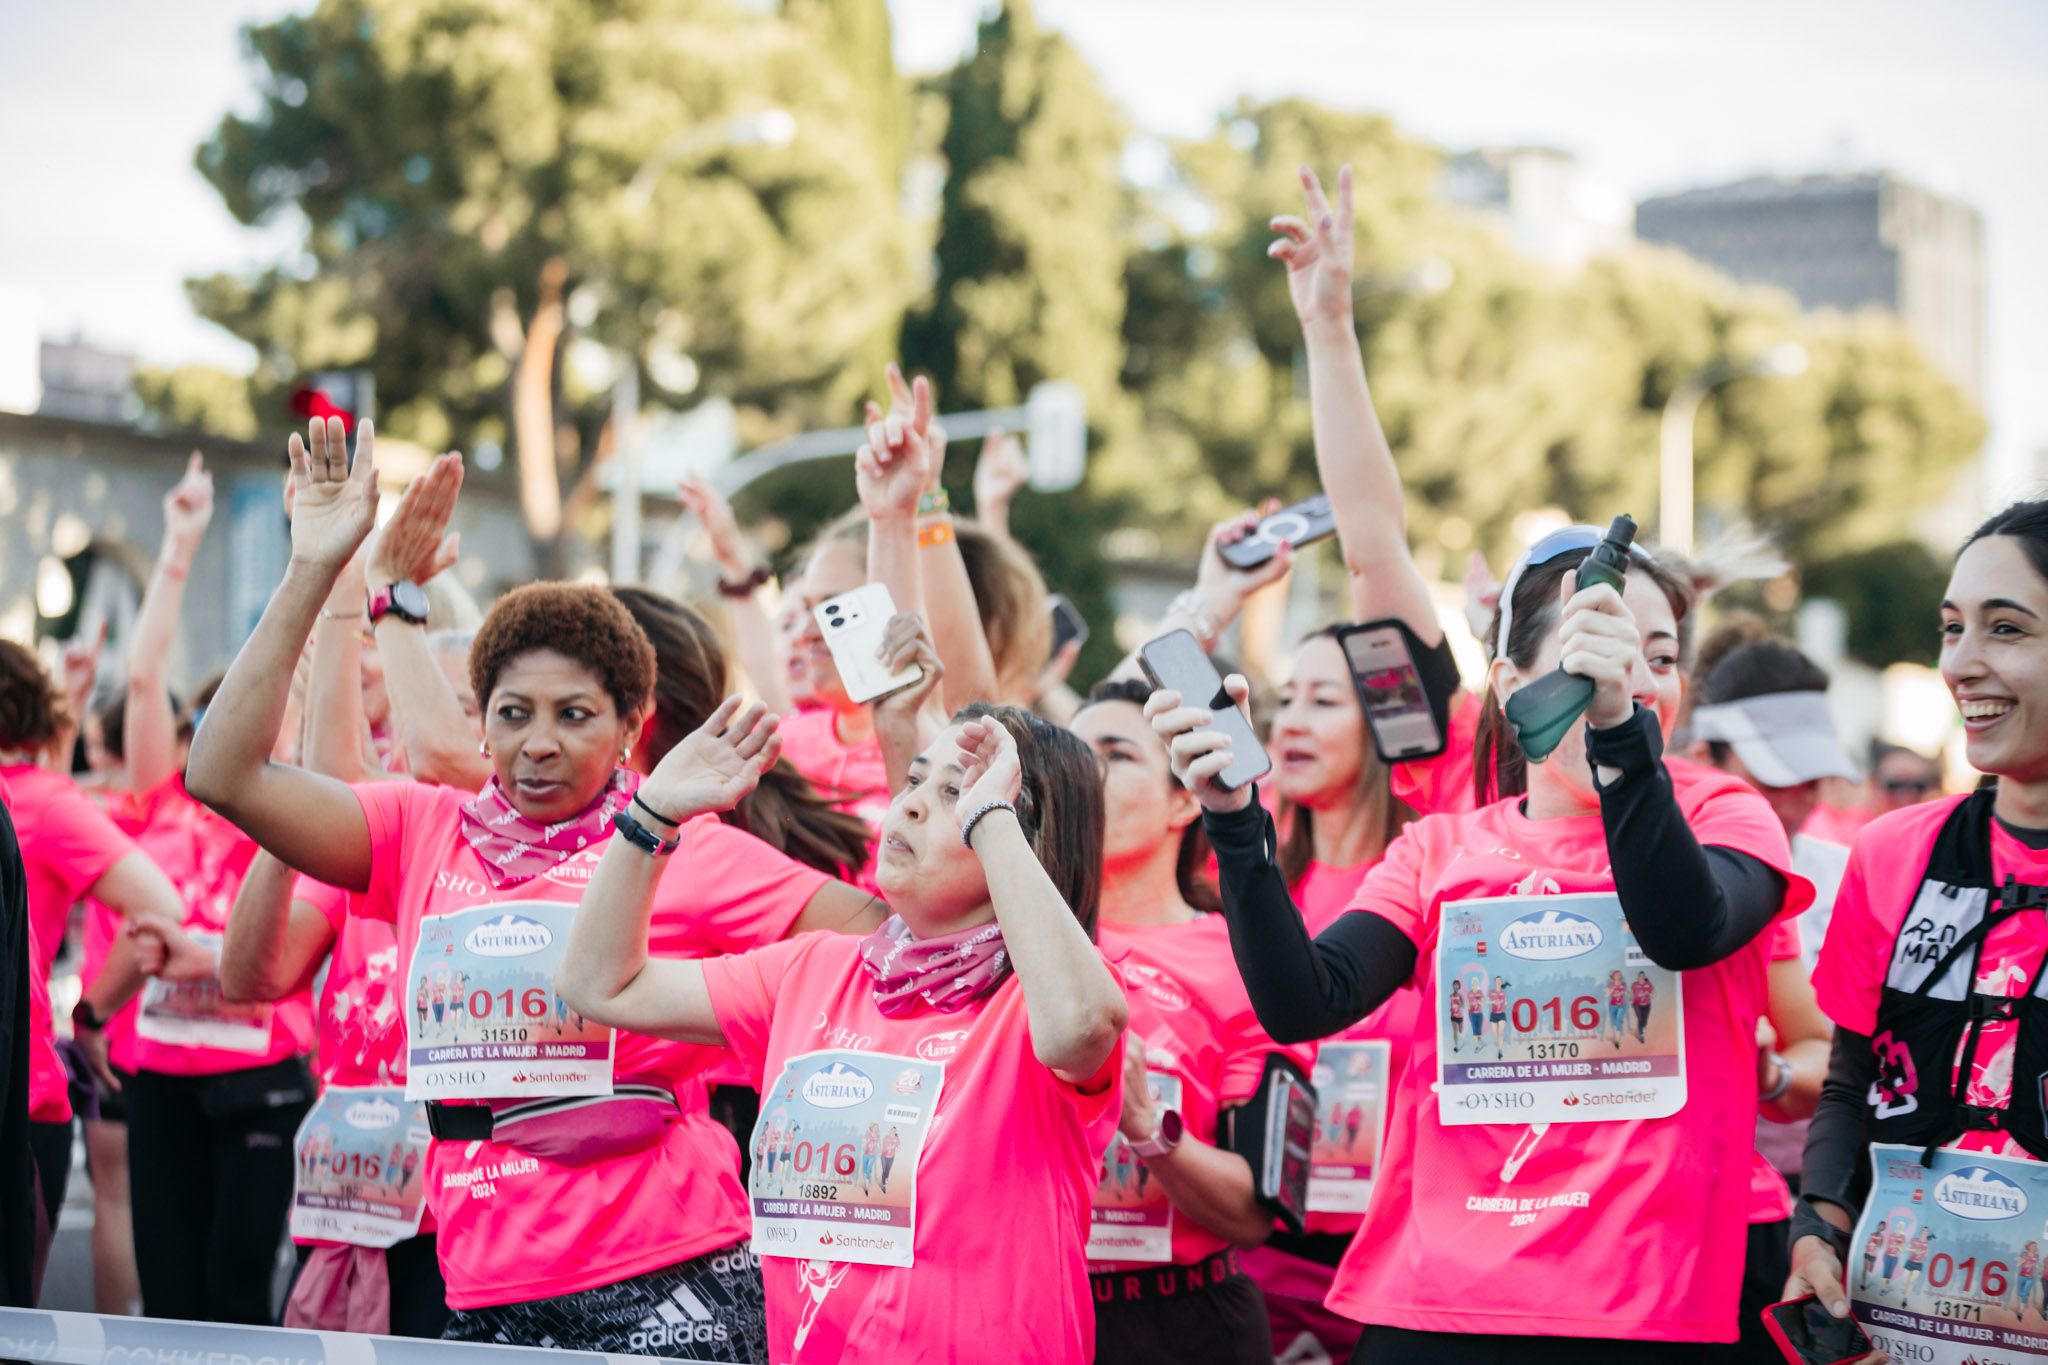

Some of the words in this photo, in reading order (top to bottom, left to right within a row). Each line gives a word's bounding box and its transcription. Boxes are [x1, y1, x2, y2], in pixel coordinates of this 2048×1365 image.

[470, 933, 547, 949] ASTURIANA
[1506, 930, 1596, 949] ASTURIANA
[1900, 942, 1952, 966] MA
[469, 988, 548, 1019] 016
[1512, 996, 1600, 1033] 016
[481, 1028, 528, 1042] 31510
[428, 1048, 469, 1062] CARRERA
[471, 1047, 485, 1058] DE
[487, 1046, 500, 1058] LA
[503, 1045, 537, 1057] MUJER
[545, 1044, 587, 1057] MADRID
[1528, 1043, 1579, 1059] 13170
[426, 1070, 486, 1087] OYSHO
[529, 1070, 588, 1083] Santander
[1467, 1066, 1514, 1080] CARRERA
[1517, 1065, 1532, 1078] DE
[1535, 1064, 1549, 1077] LA
[1551, 1063, 1592, 1076] MUJER
[1602, 1061, 1652, 1075] MADRID
[806, 1081, 867, 1099] ASTURIANA
[1583, 1090, 1657, 1106] Santander
[1466, 1092, 1535, 1110] OYSHO
[331, 1152, 382, 1180] 016
[793, 1141, 857, 1177] 016
[486, 1163, 500, 1180] LA
[500, 1158, 539, 1177] MUJER
[471, 1181, 497, 1199] 2024
[798, 1183, 838, 1200] 18892
[1938, 1182, 2020, 1213] ASTURIANA
[763, 1202, 788, 1213] CARRERA
[789, 1203, 799, 1214] DE
[799, 1204, 811, 1215] LA
[813, 1205, 846, 1218] MUJER
[854, 1208, 891, 1221] MADRID
[1466, 1196, 1517, 1212] CARRERA
[1519, 1199, 1535, 1211] DE
[1535, 1198, 1549, 1210] LA
[1549, 1192, 1590, 1208] MUJER
[836, 1234, 894, 1250] Santander
[1927, 1253, 2009, 1296] 016
[1934, 1300, 1981, 1322] 13171
[629, 1321, 728, 1350] adidas
[1870, 1309, 1916, 1330] CARRERA
[1920, 1319, 1934, 1333] DE
[1936, 1321, 1950, 1336] LA
[1953, 1324, 1993, 1341] MUJER
[2003, 1332, 2048, 1350] MADRID
